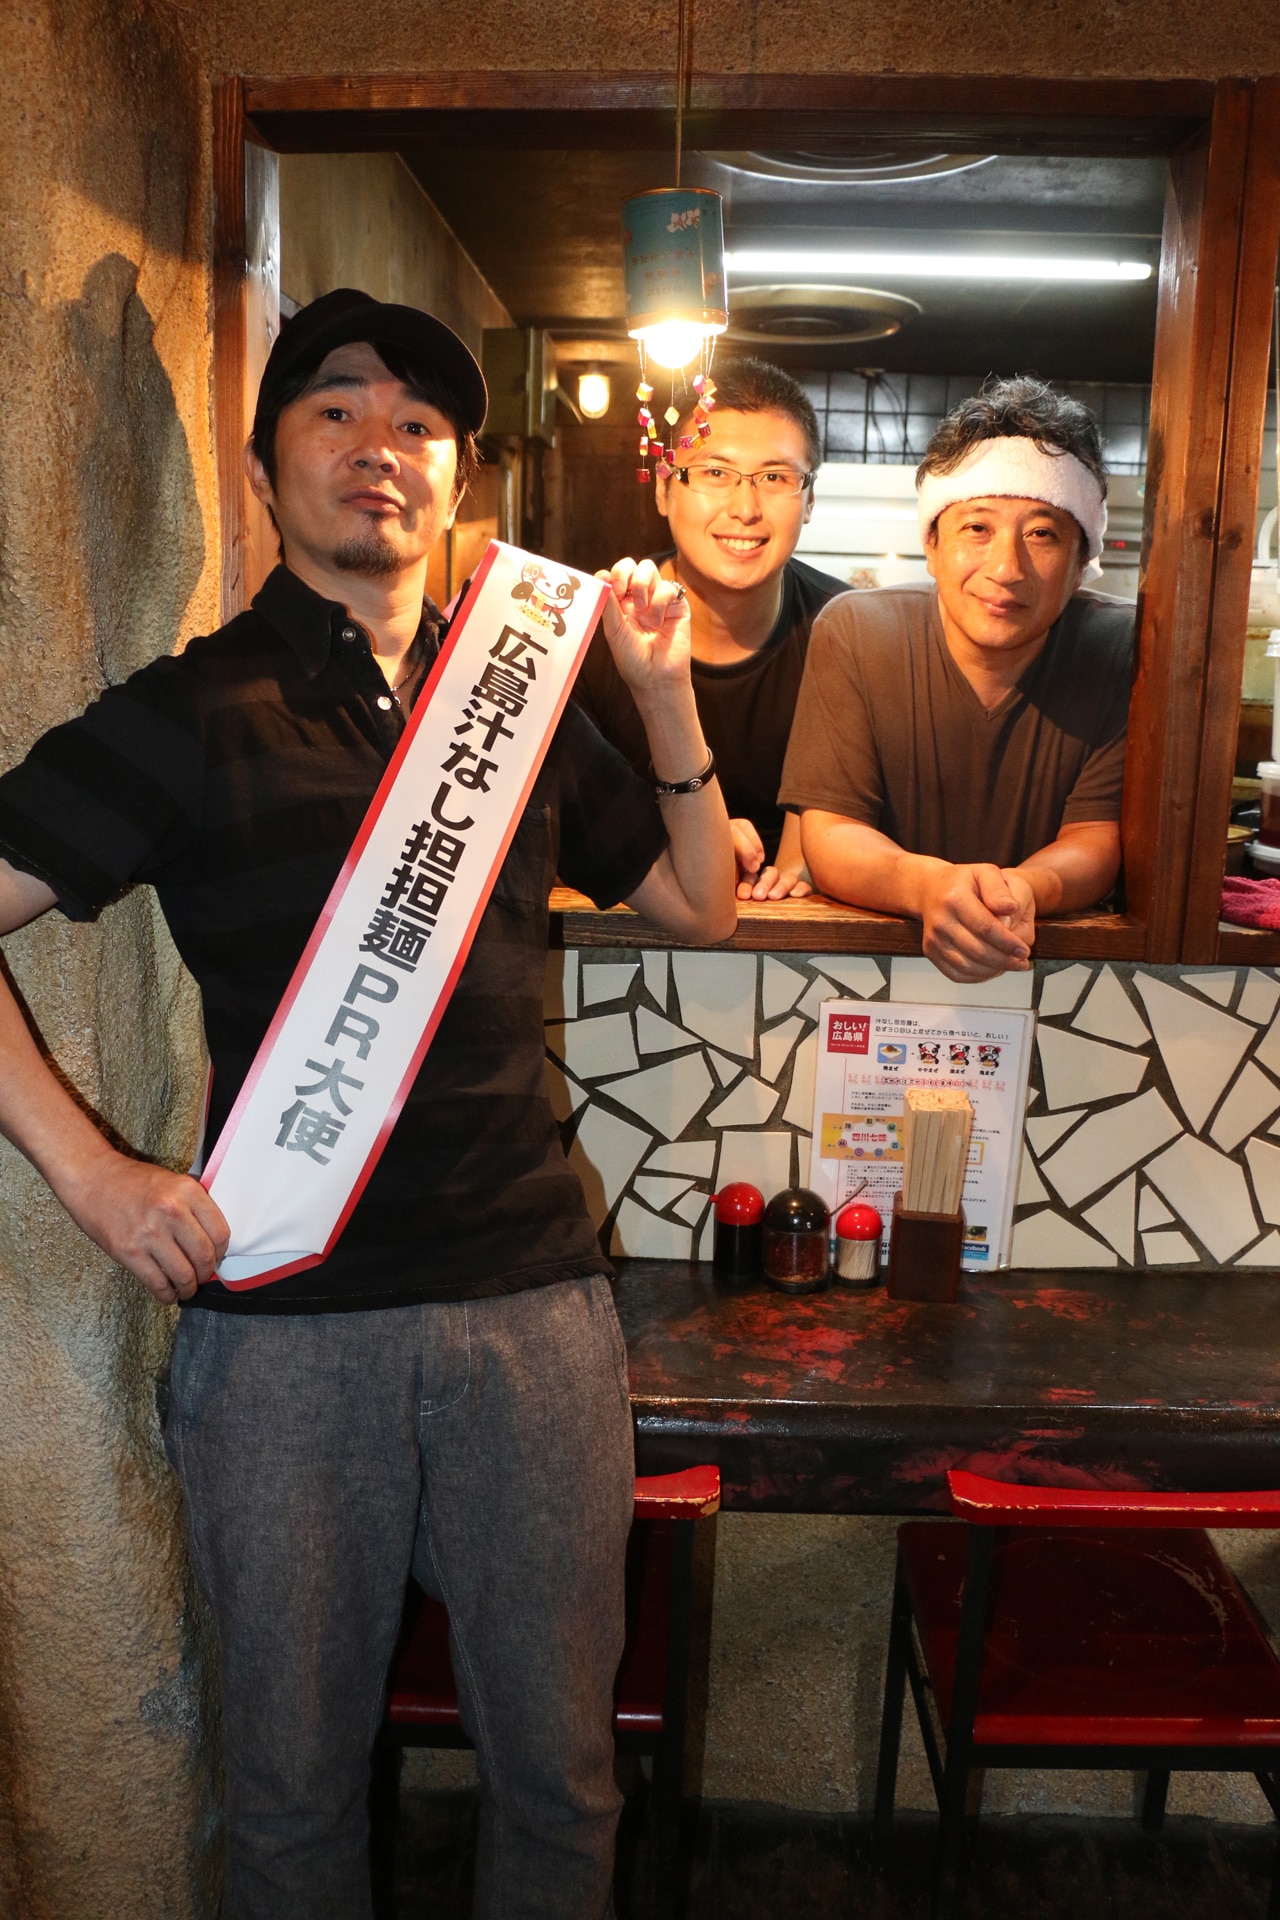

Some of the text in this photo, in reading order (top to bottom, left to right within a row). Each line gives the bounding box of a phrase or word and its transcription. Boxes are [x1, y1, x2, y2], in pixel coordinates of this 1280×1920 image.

[831, 1031, 863, 1042] 広島県
[851, 1132, 888, 1144] 四川七味
